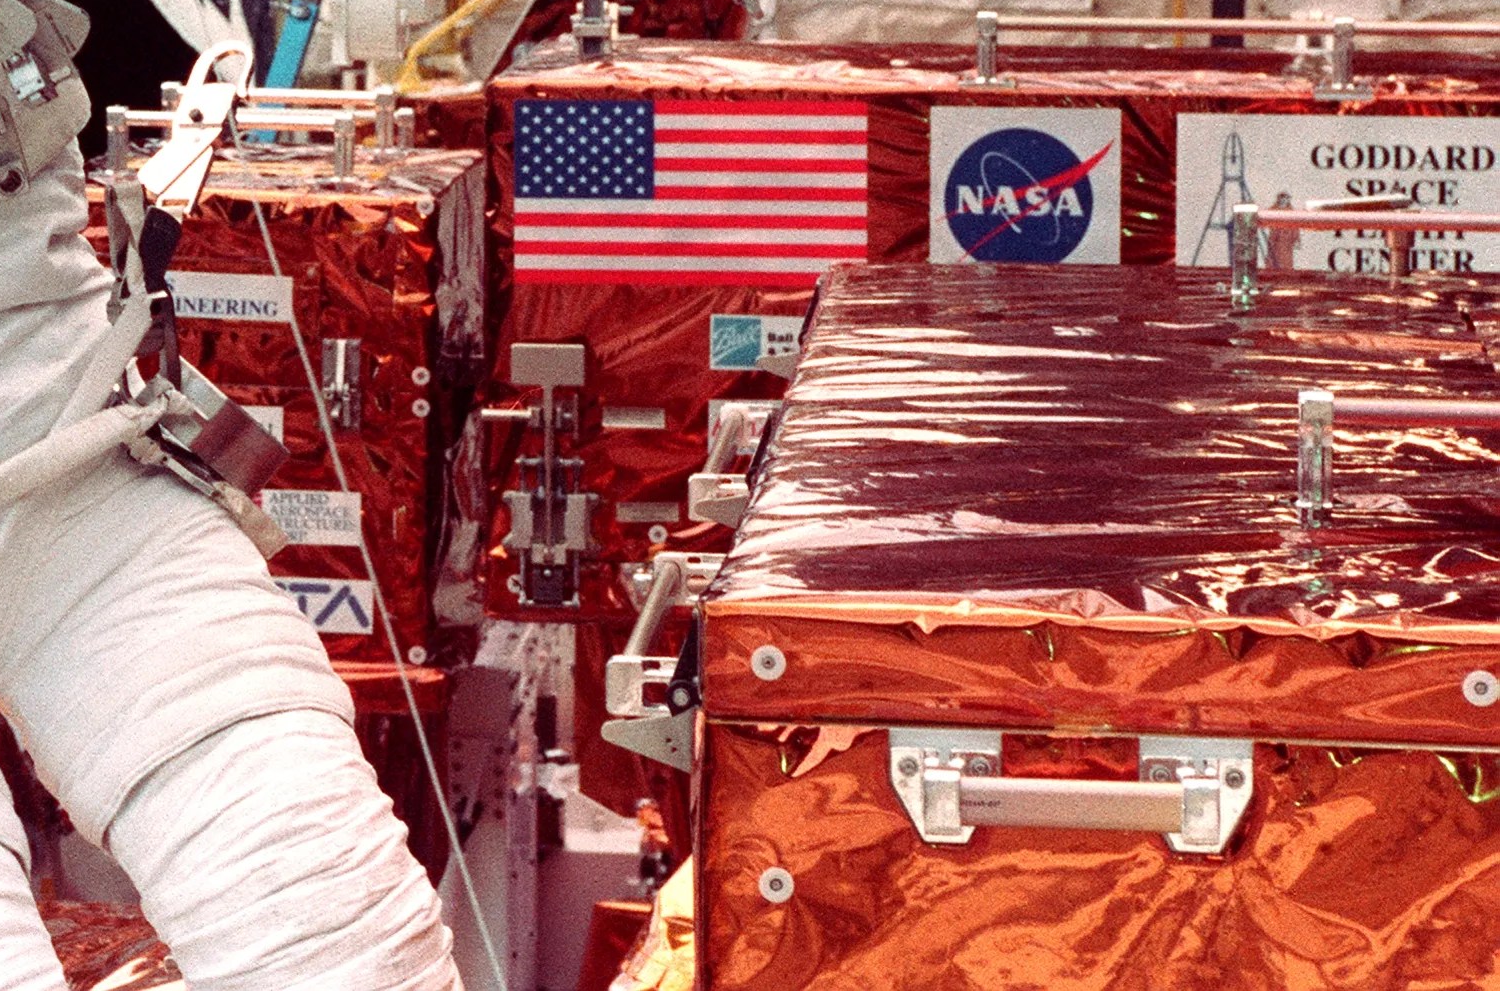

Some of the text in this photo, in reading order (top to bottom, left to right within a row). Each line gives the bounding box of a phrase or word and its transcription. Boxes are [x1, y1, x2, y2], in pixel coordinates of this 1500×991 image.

[1310, 143, 1495, 172] GODDARD
[956, 184, 1084, 217] NASA
[175, 295, 278, 317] INEERING
[269, 492, 330, 505] APPLIED
